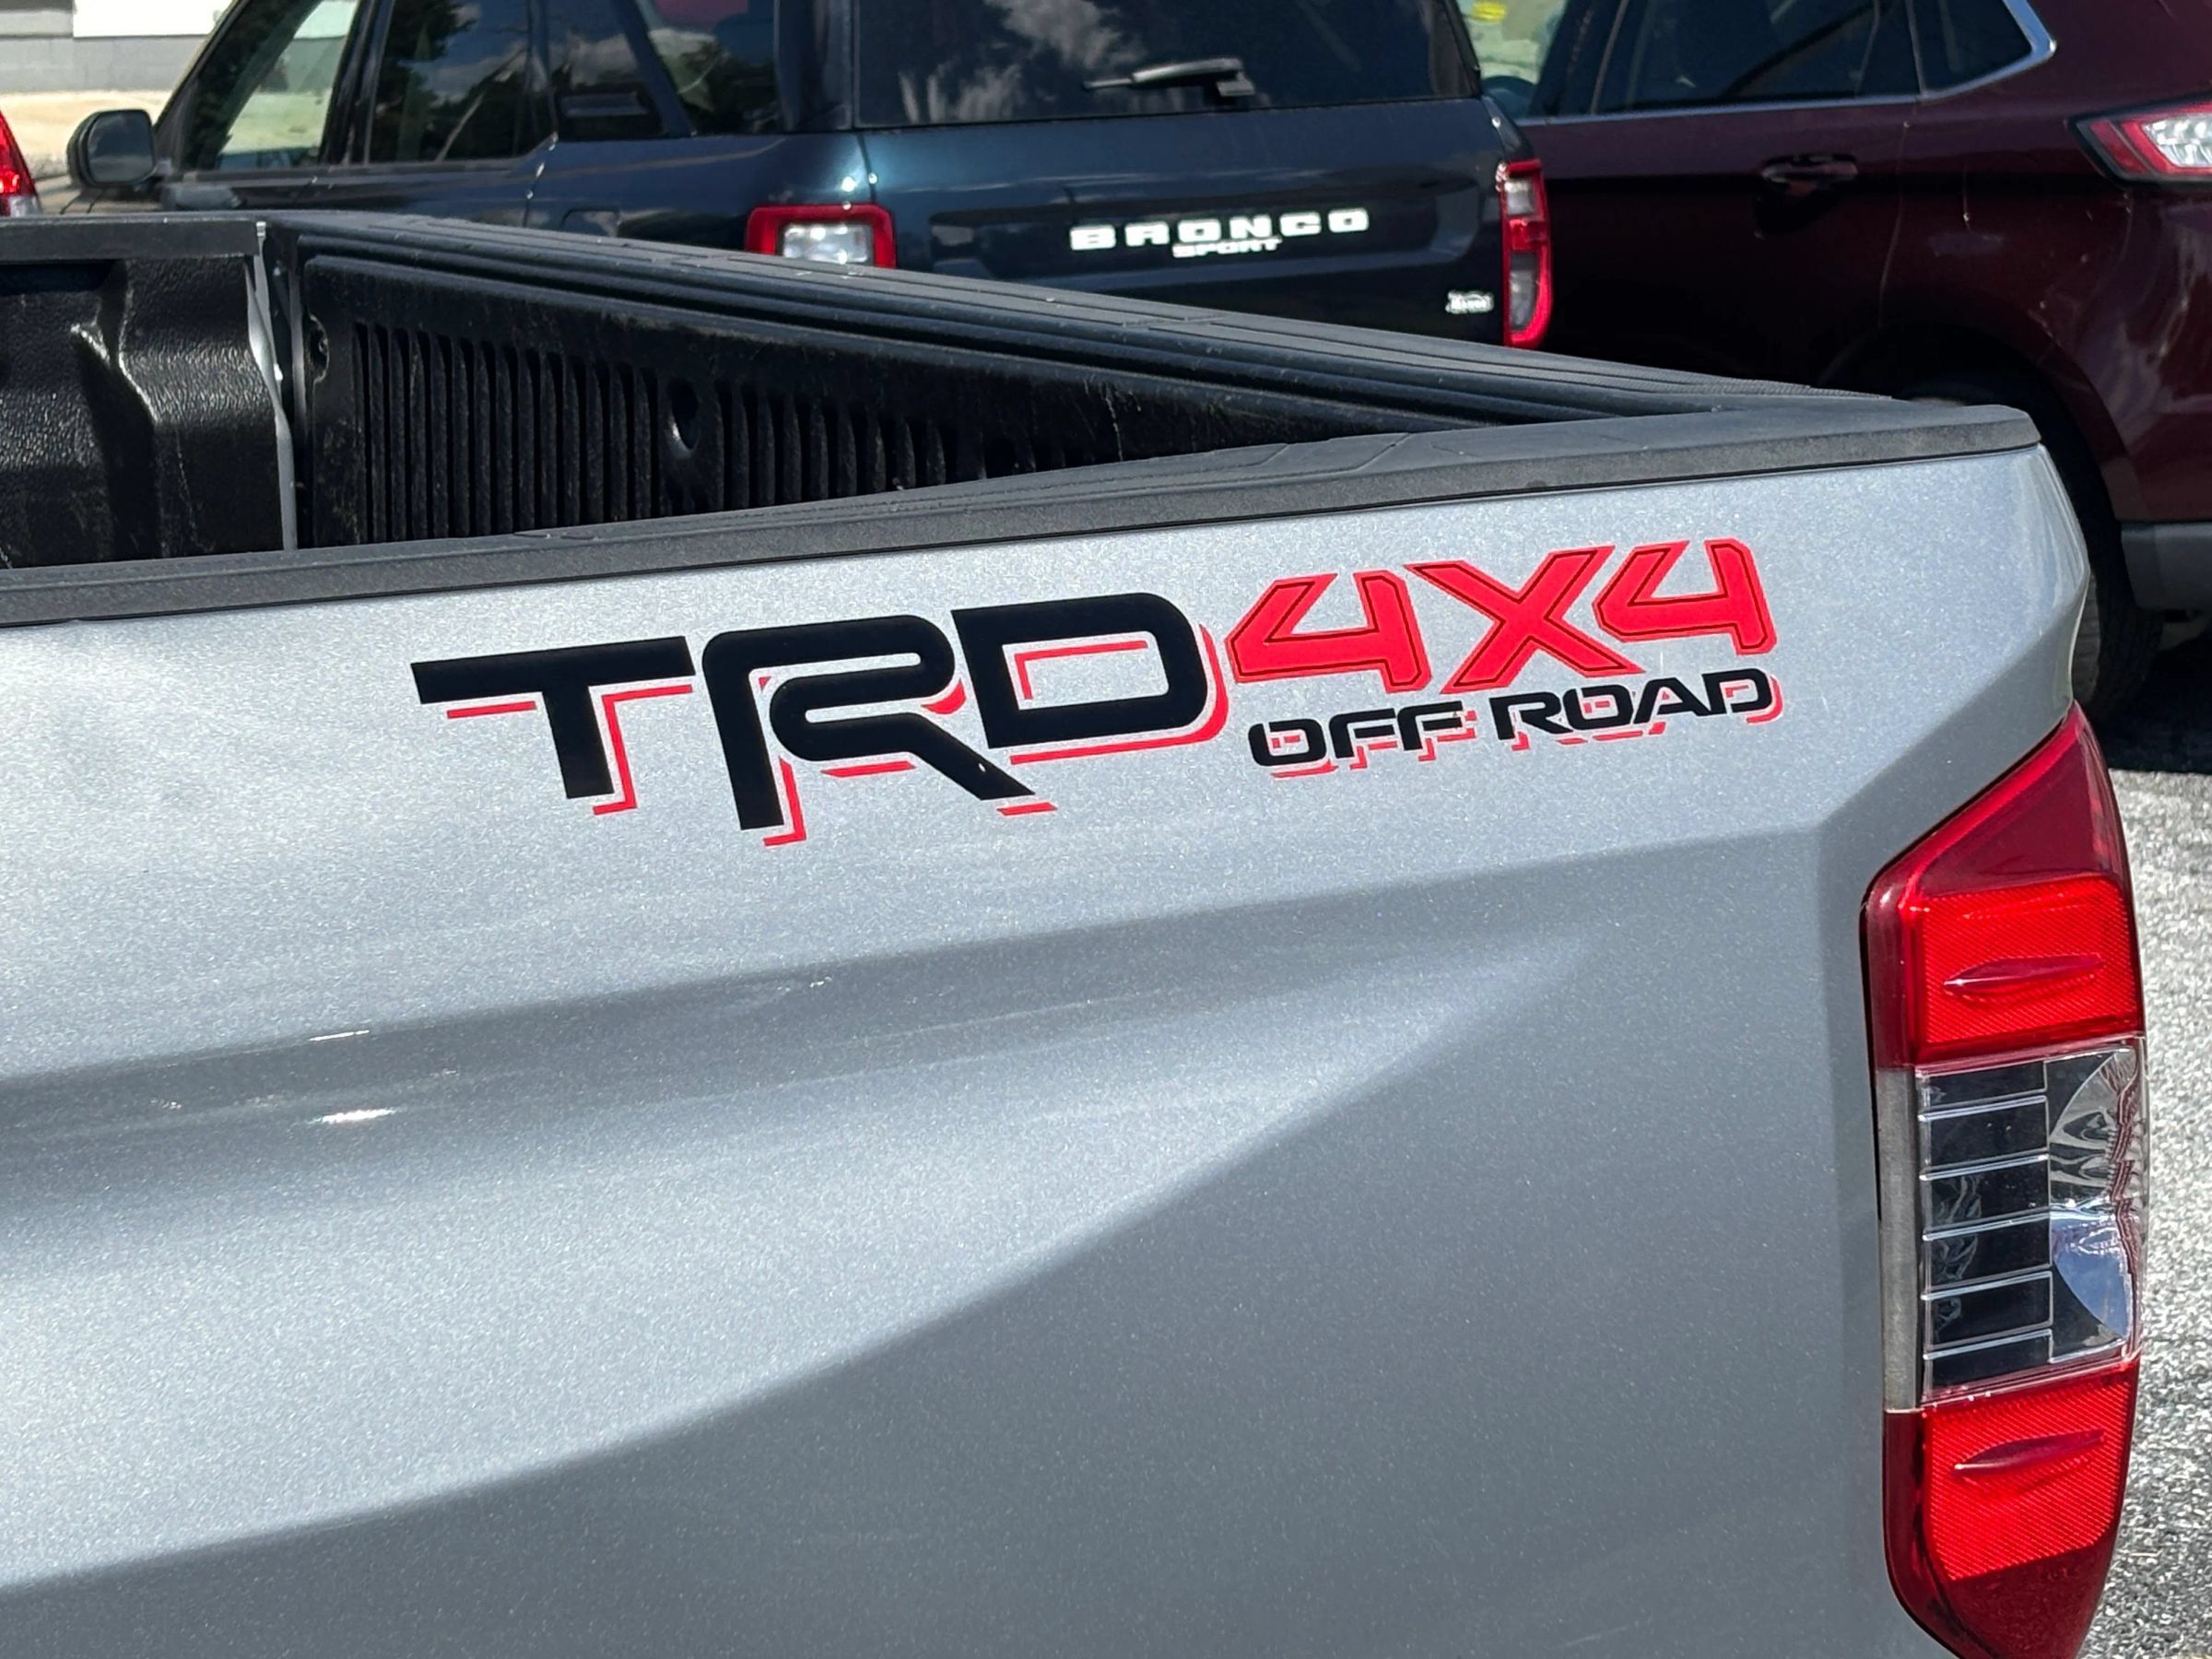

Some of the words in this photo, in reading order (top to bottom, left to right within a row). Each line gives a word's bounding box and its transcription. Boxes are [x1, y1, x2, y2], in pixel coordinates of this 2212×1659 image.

[1069, 207, 1370, 252] BRONCO
[1171, 236, 1283, 259] SPORT
[410, 592, 1228, 846] TRD
[1225, 537, 1778, 695] 4X4
[1248, 700, 1477, 778] OFF
[1488, 666, 1783, 751] ROAD
